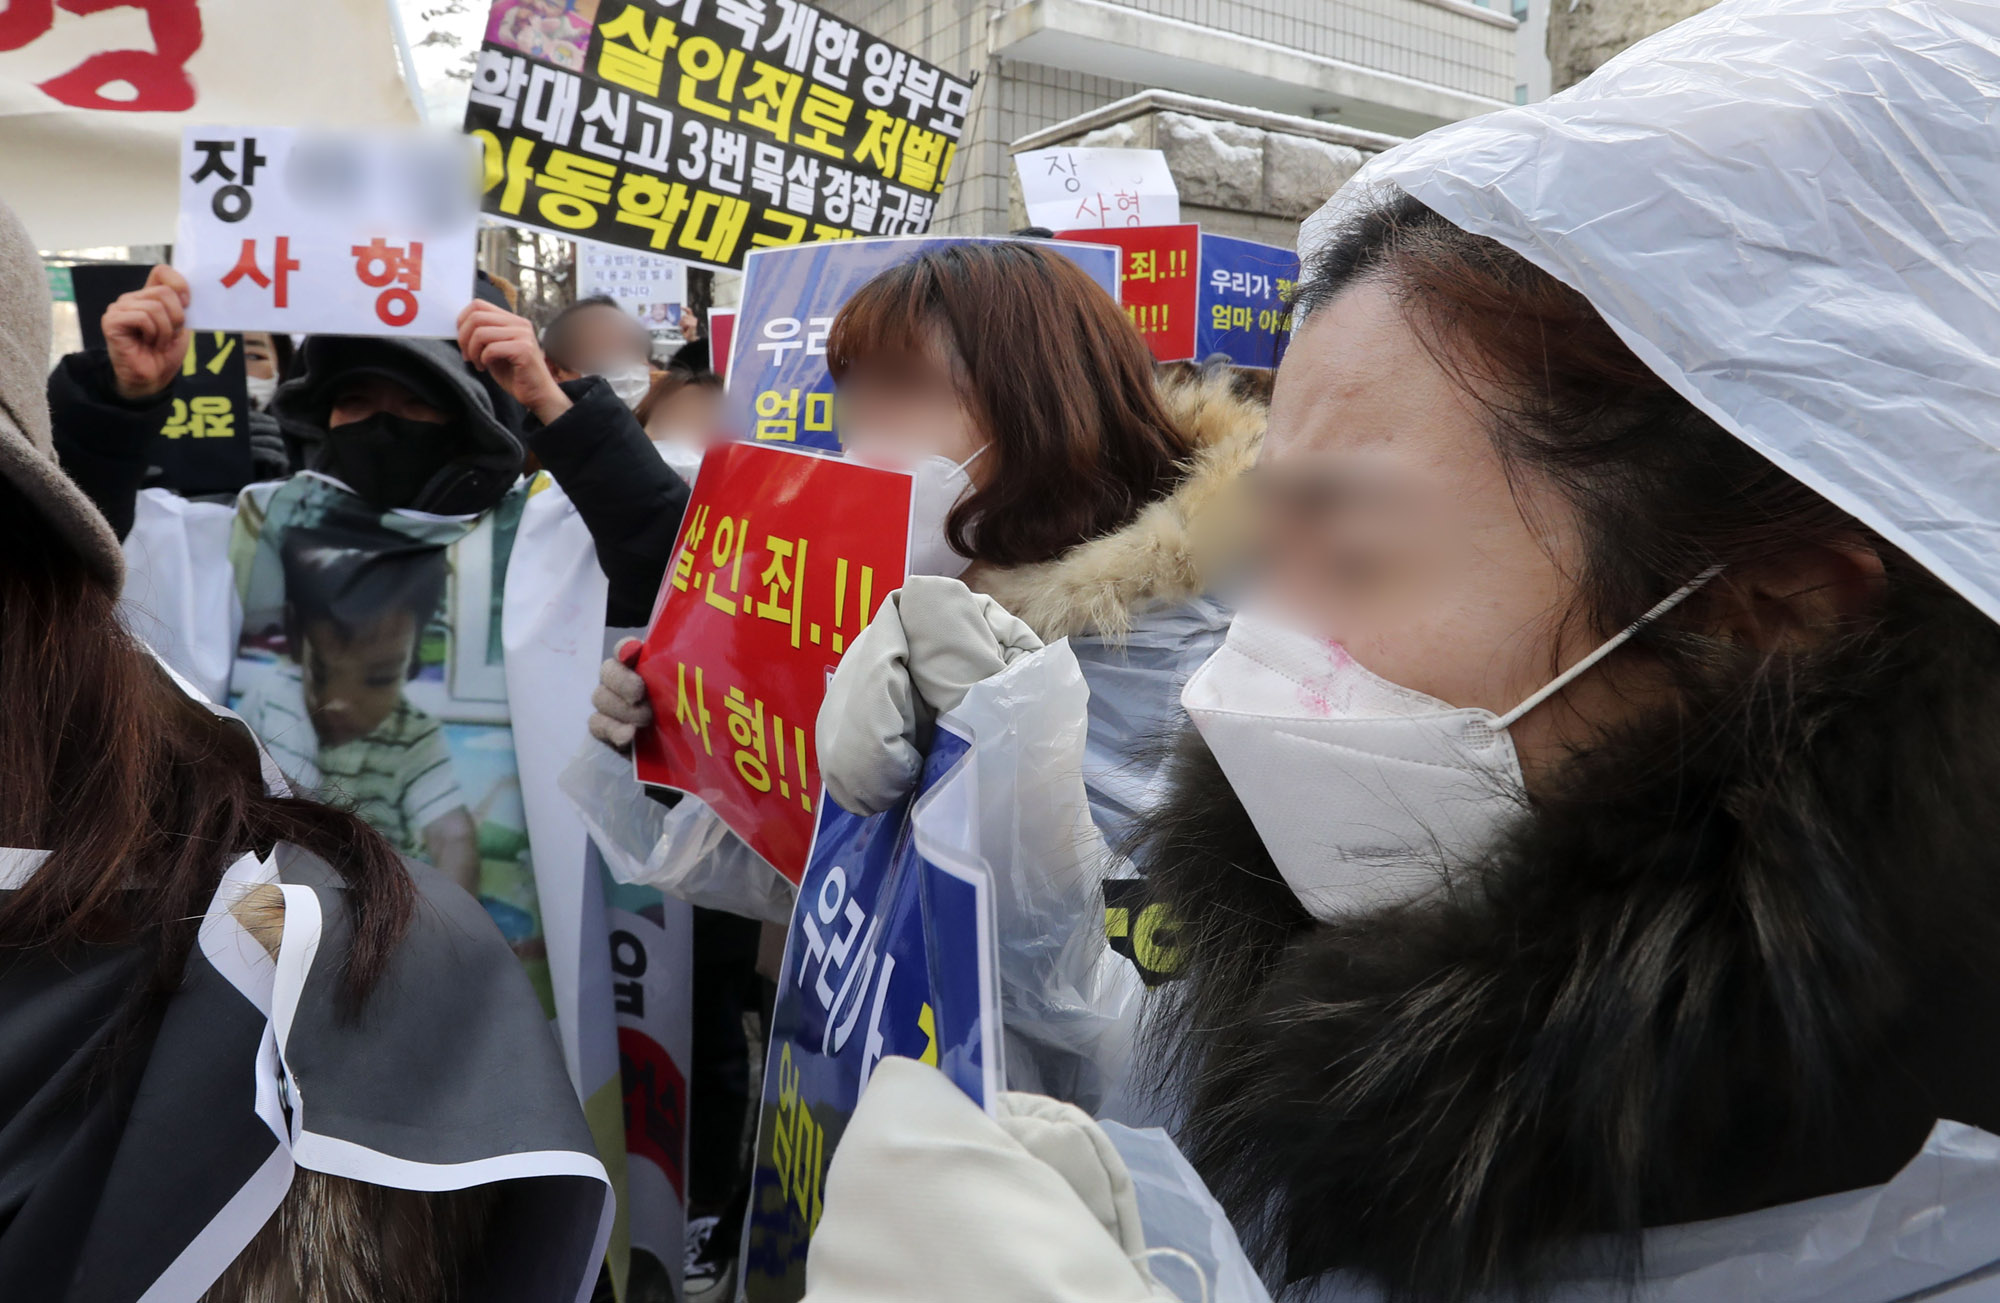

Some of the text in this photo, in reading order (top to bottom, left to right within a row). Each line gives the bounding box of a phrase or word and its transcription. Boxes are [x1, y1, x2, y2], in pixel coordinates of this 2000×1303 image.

[471, 49, 674, 173] 학대신고
[677, 119, 748, 195] 3번
[597, 4, 854, 159] 살인죄로
[863, 43, 973, 138] 양부모
[190, 137, 266, 222] 장
[469, 128, 751, 264] 아동학대
[1044, 153, 1080, 192] 장
[1210, 269, 1271, 299] 우리가
[1211, 304, 1253, 332] 엄마
